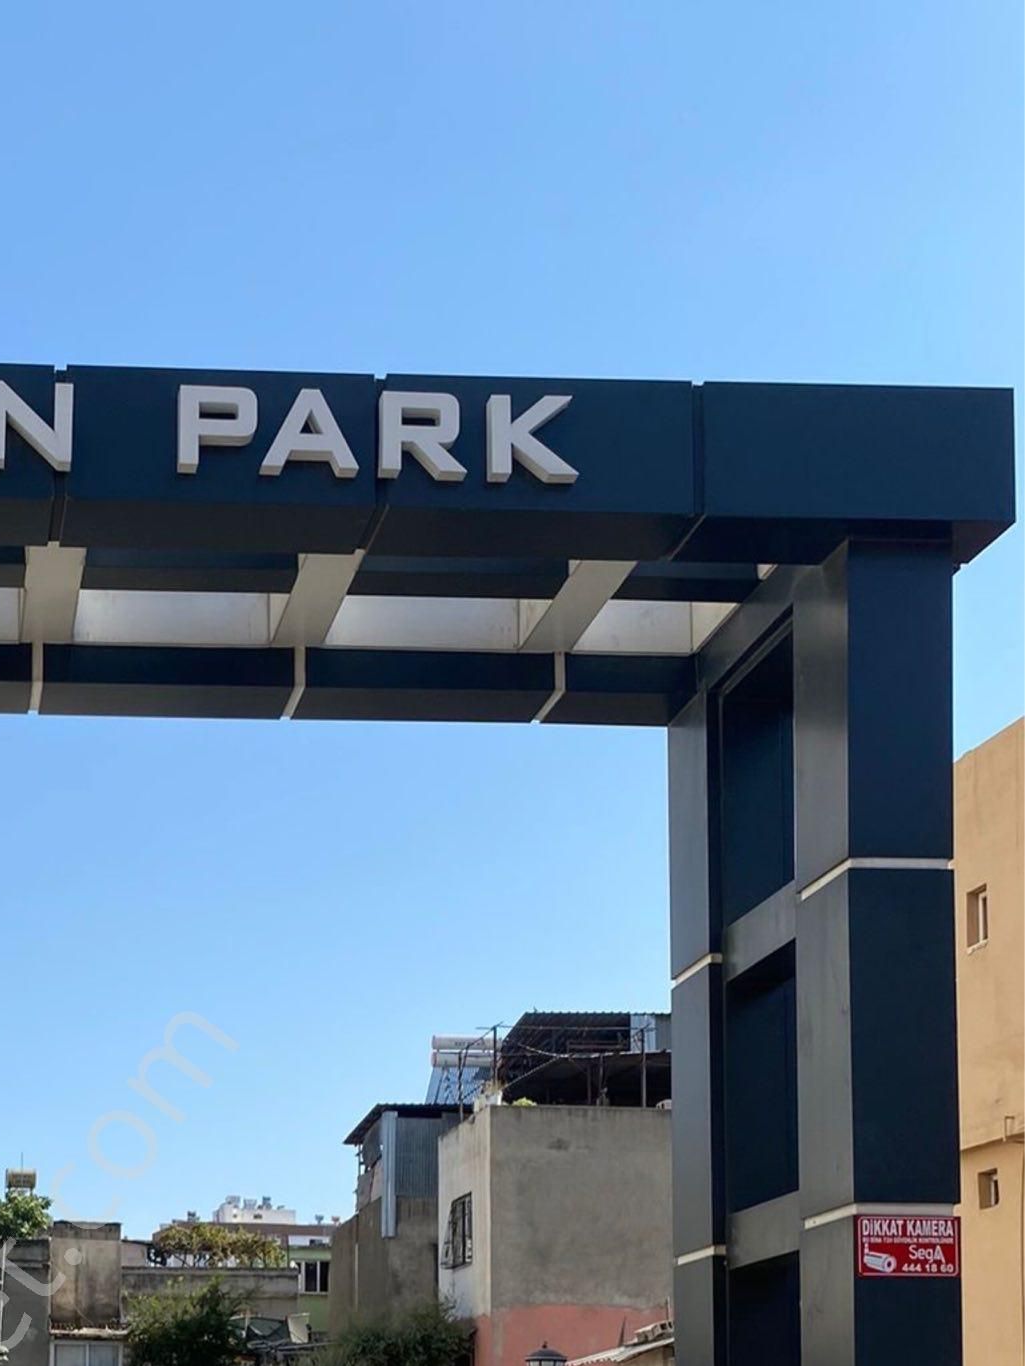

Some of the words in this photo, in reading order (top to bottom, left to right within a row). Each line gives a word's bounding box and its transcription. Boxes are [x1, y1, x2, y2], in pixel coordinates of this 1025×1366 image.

[177, 384, 579, 484] PARK
[906, 1220, 954, 1236] KAMERA
[902, 1263, 922, 1273] 444
